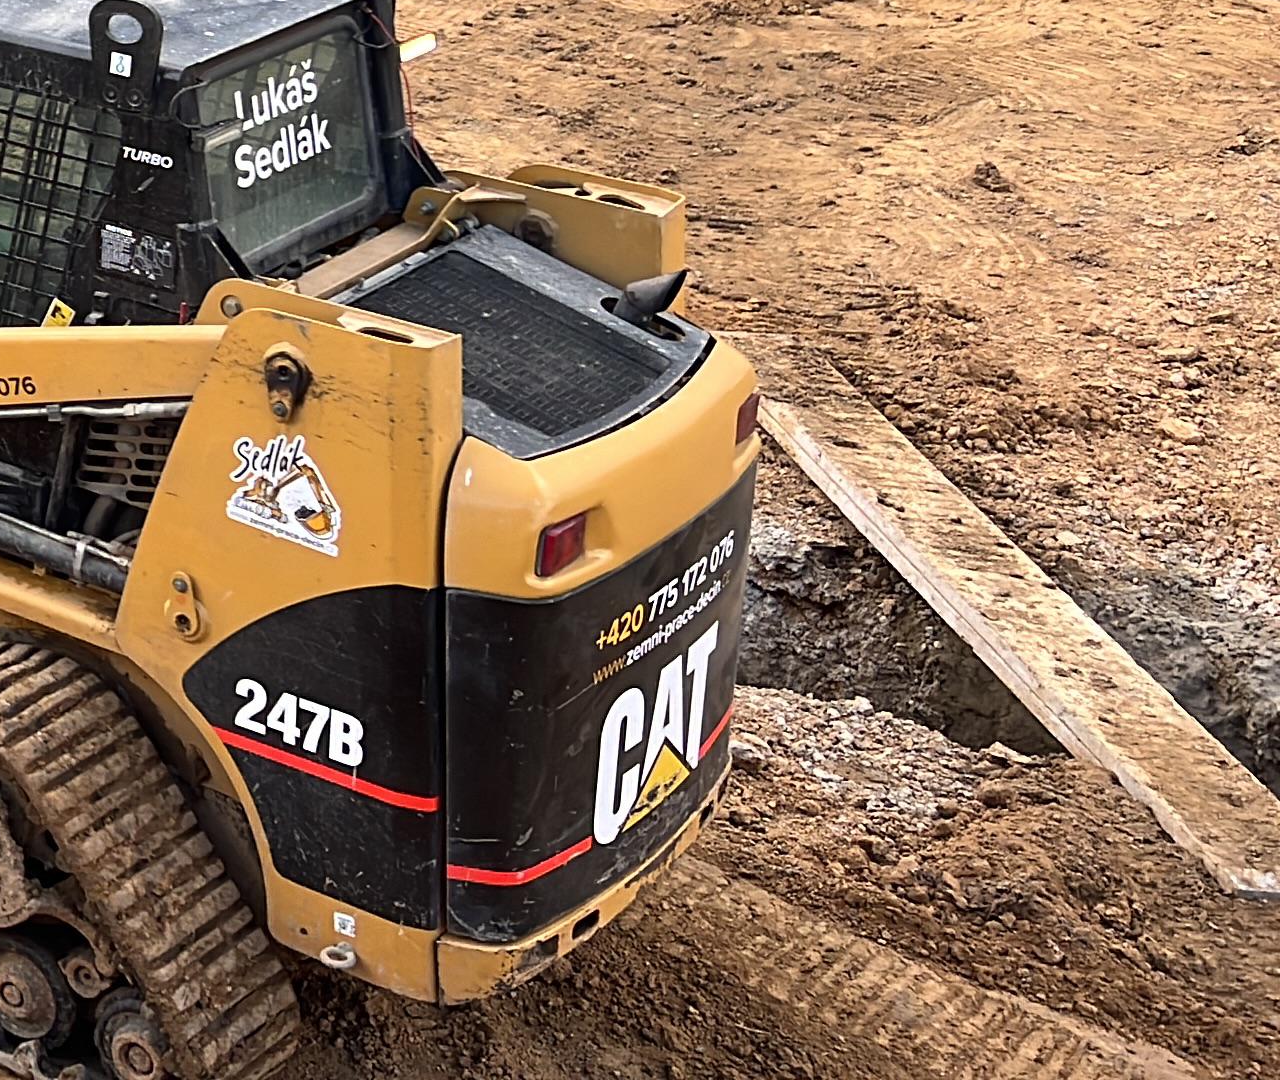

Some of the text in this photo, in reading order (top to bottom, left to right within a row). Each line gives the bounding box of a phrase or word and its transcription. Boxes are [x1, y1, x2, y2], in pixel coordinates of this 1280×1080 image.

[234, 58, 318, 132] Lukáš
[122, 146, 174, 169] TURBO
[234, 113, 332, 188] Sedlák
[234, 438, 304, 479] Sedlák
[596, 529, 735, 650] +420 775 172 076
[234, 678, 364, 767] 247B
[593, 620, 718, 845] CAT
